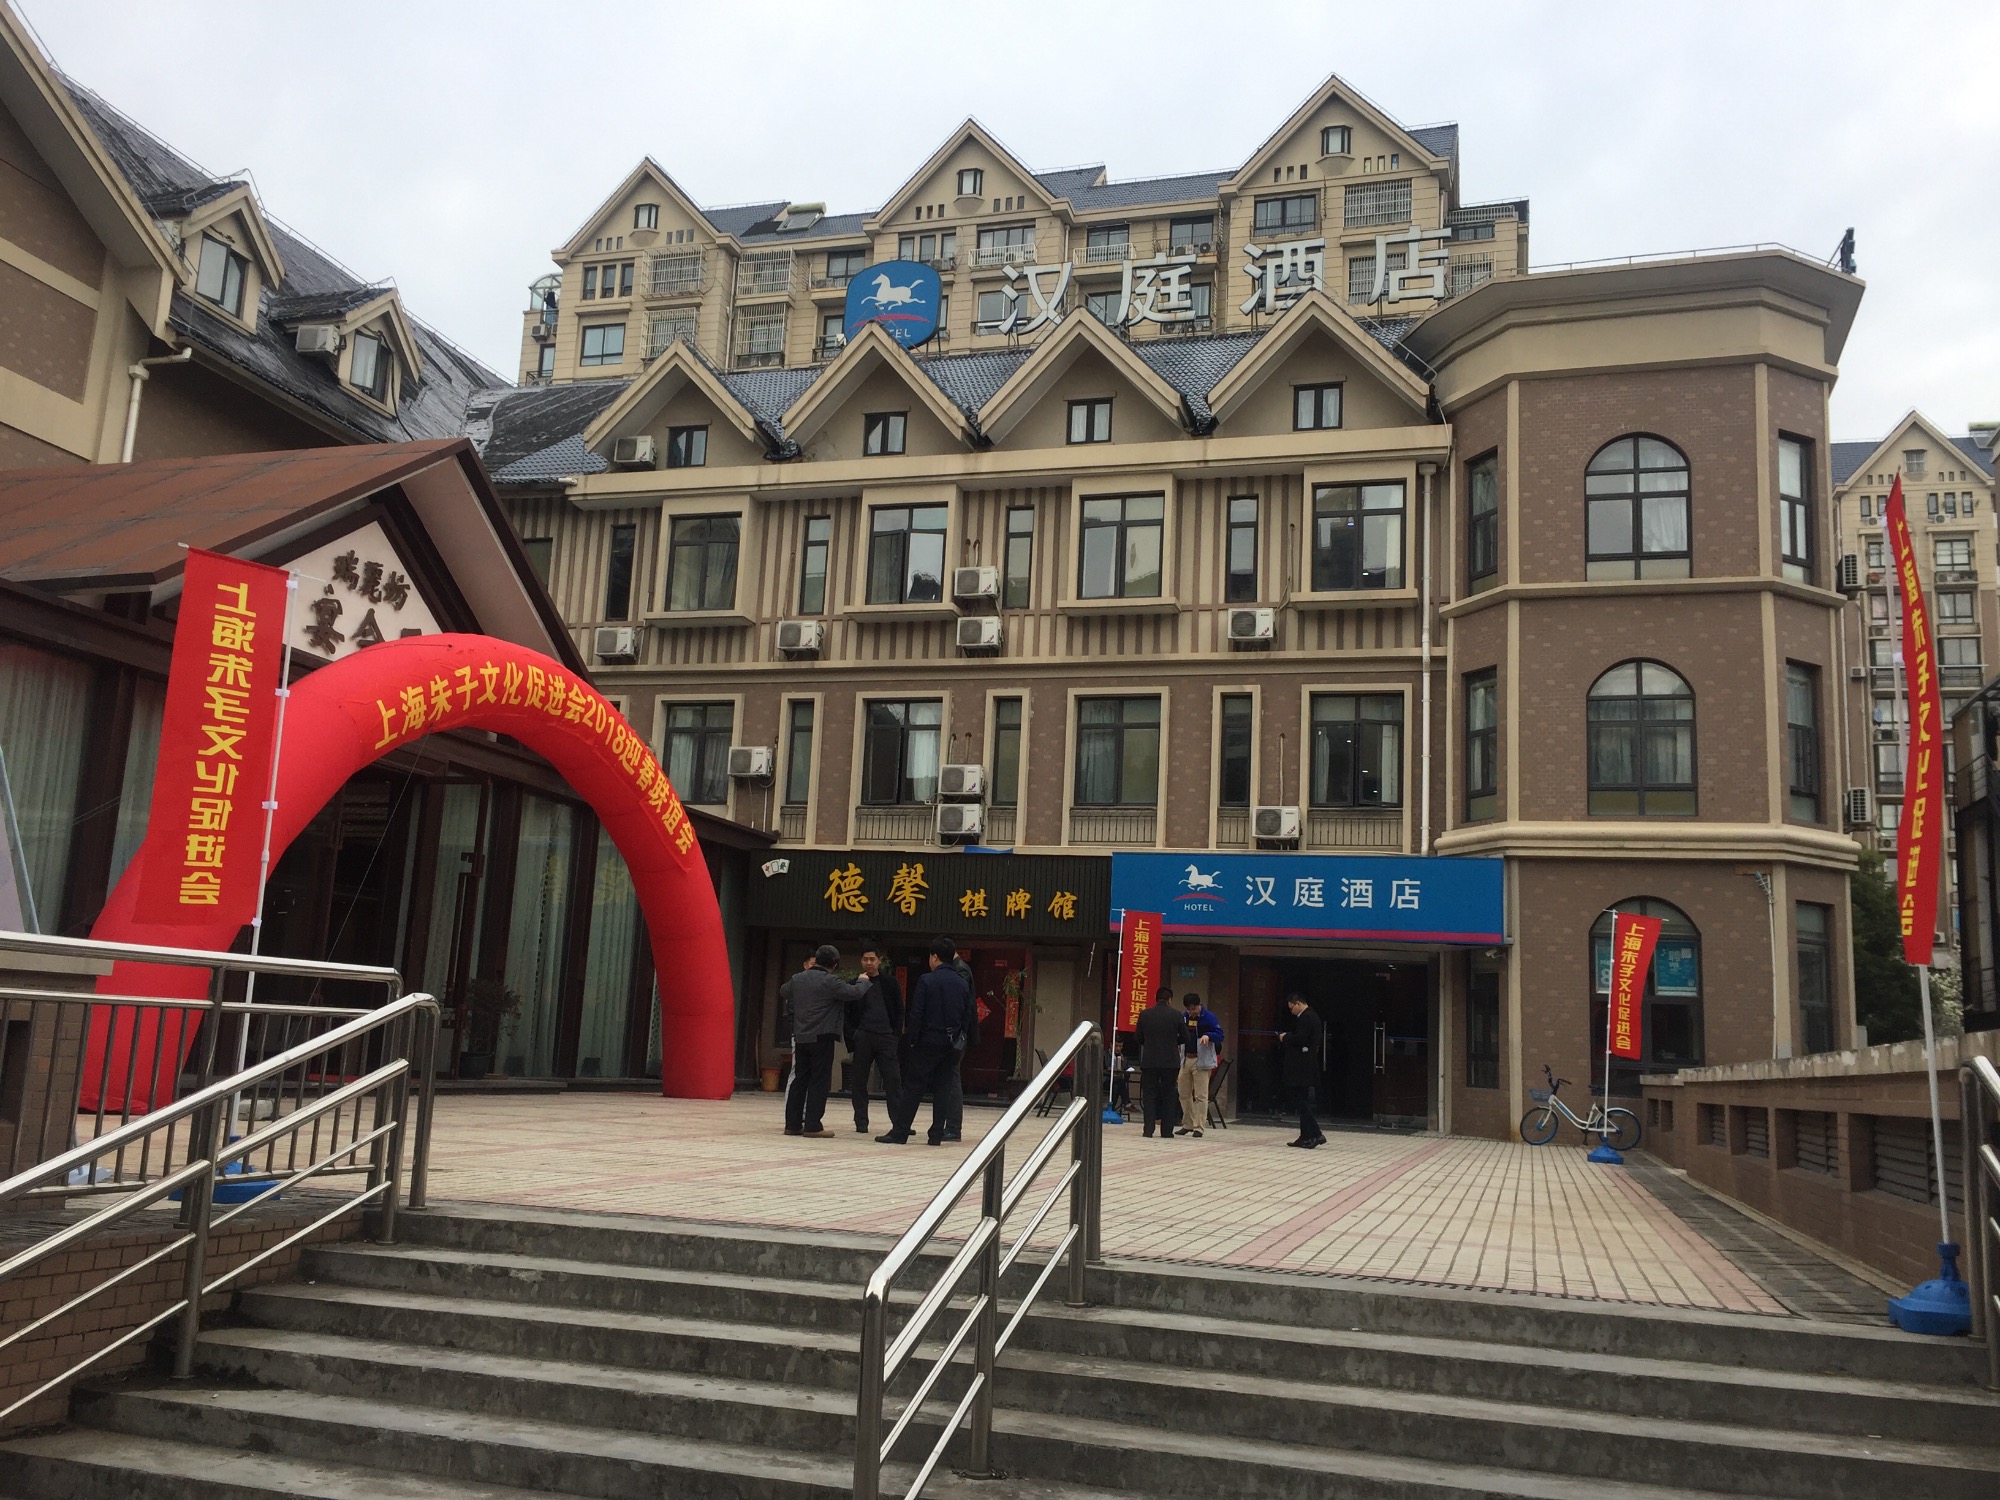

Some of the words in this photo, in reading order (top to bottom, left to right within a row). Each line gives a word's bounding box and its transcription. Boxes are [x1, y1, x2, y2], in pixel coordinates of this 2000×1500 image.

[997, 225, 1453, 336] 汉庭酒店
[303, 583, 423, 654] 宴会
[374, 660, 695, 855] 上海朱子文化促进会2018迎春联谊会
[1895, 517, 1931, 936] 上海朱子文化促进会
[824, 862, 930, 916] 德馨
[959, 888, 1079, 921] 棋牌馆
[1183, 903, 1215, 912] HOTEL
[1245, 875, 1422, 910] 汉庭酒店
[1616, 923, 1646, 1051] 上海朱子文化促进会
